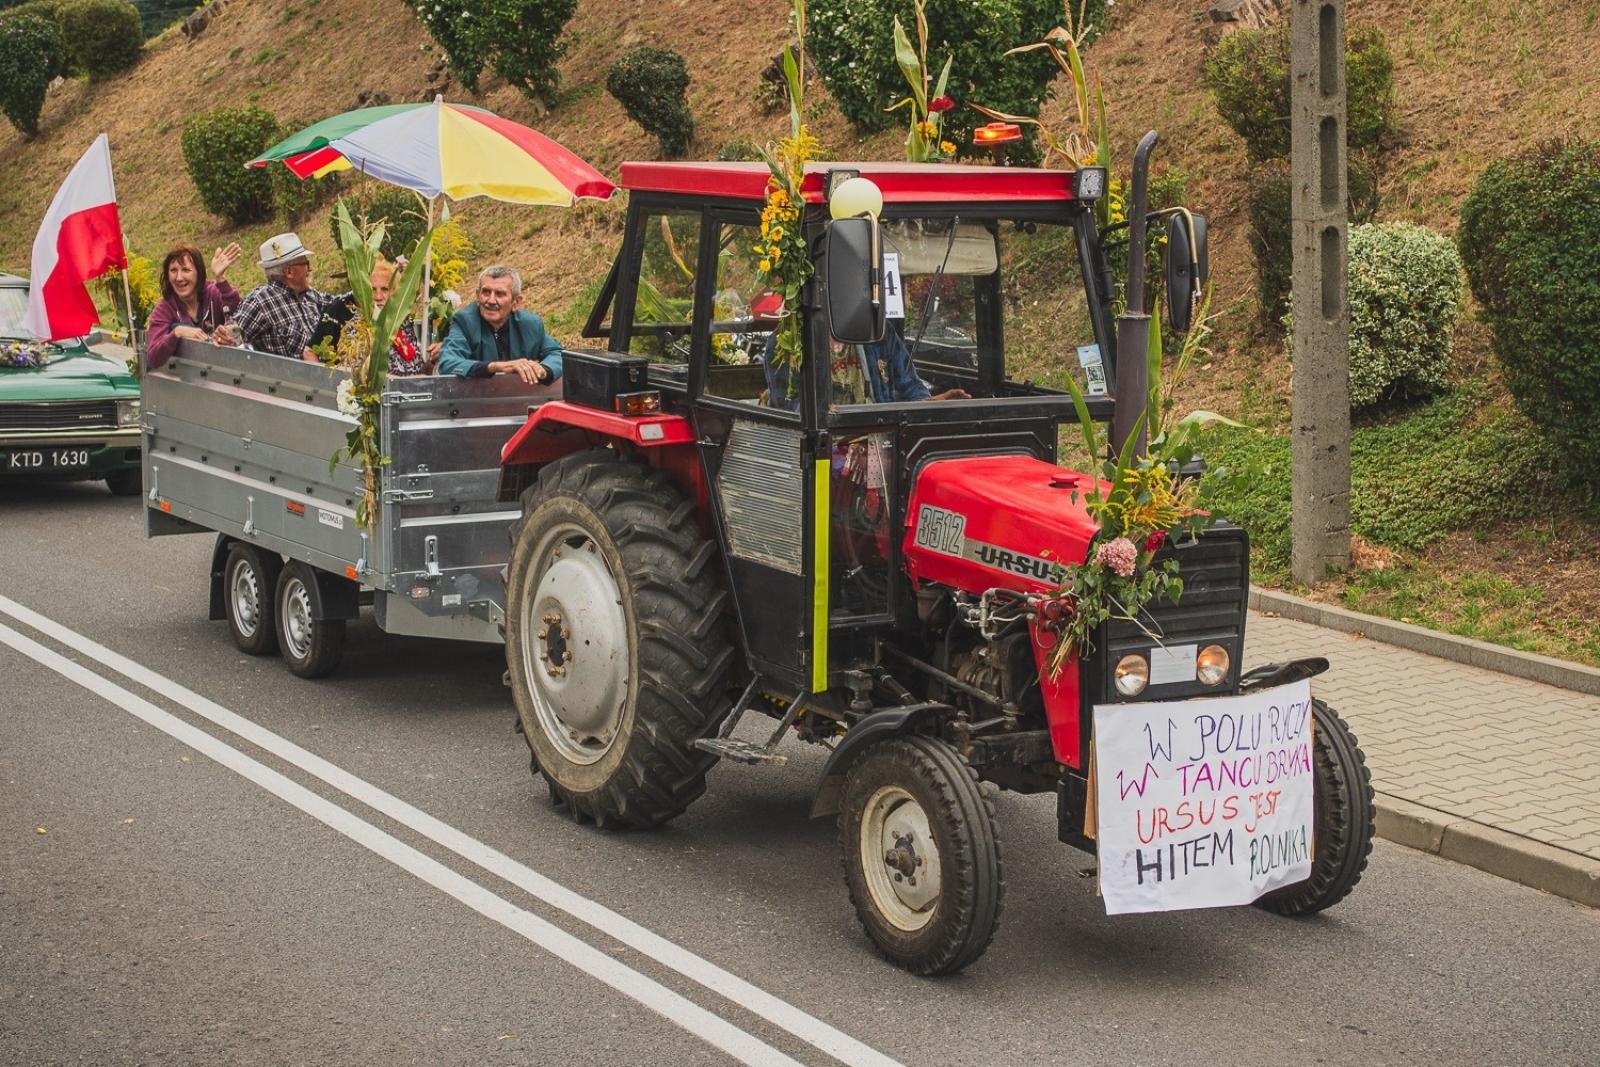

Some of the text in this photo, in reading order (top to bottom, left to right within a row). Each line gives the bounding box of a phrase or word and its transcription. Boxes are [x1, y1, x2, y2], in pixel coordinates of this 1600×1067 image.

[11, 451, 88, 467] KTD 1630
[917, 507, 964, 554] 3512
[1144, 717, 1177, 762] W
[1189, 712, 1261, 762] POLU
[1116, 744, 1311, 801] W TANCU BRYKA
[1136, 790, 1281, 844] URSUS JEST
[1136, 825, 1308, 885] HITEM ROLNIKA
